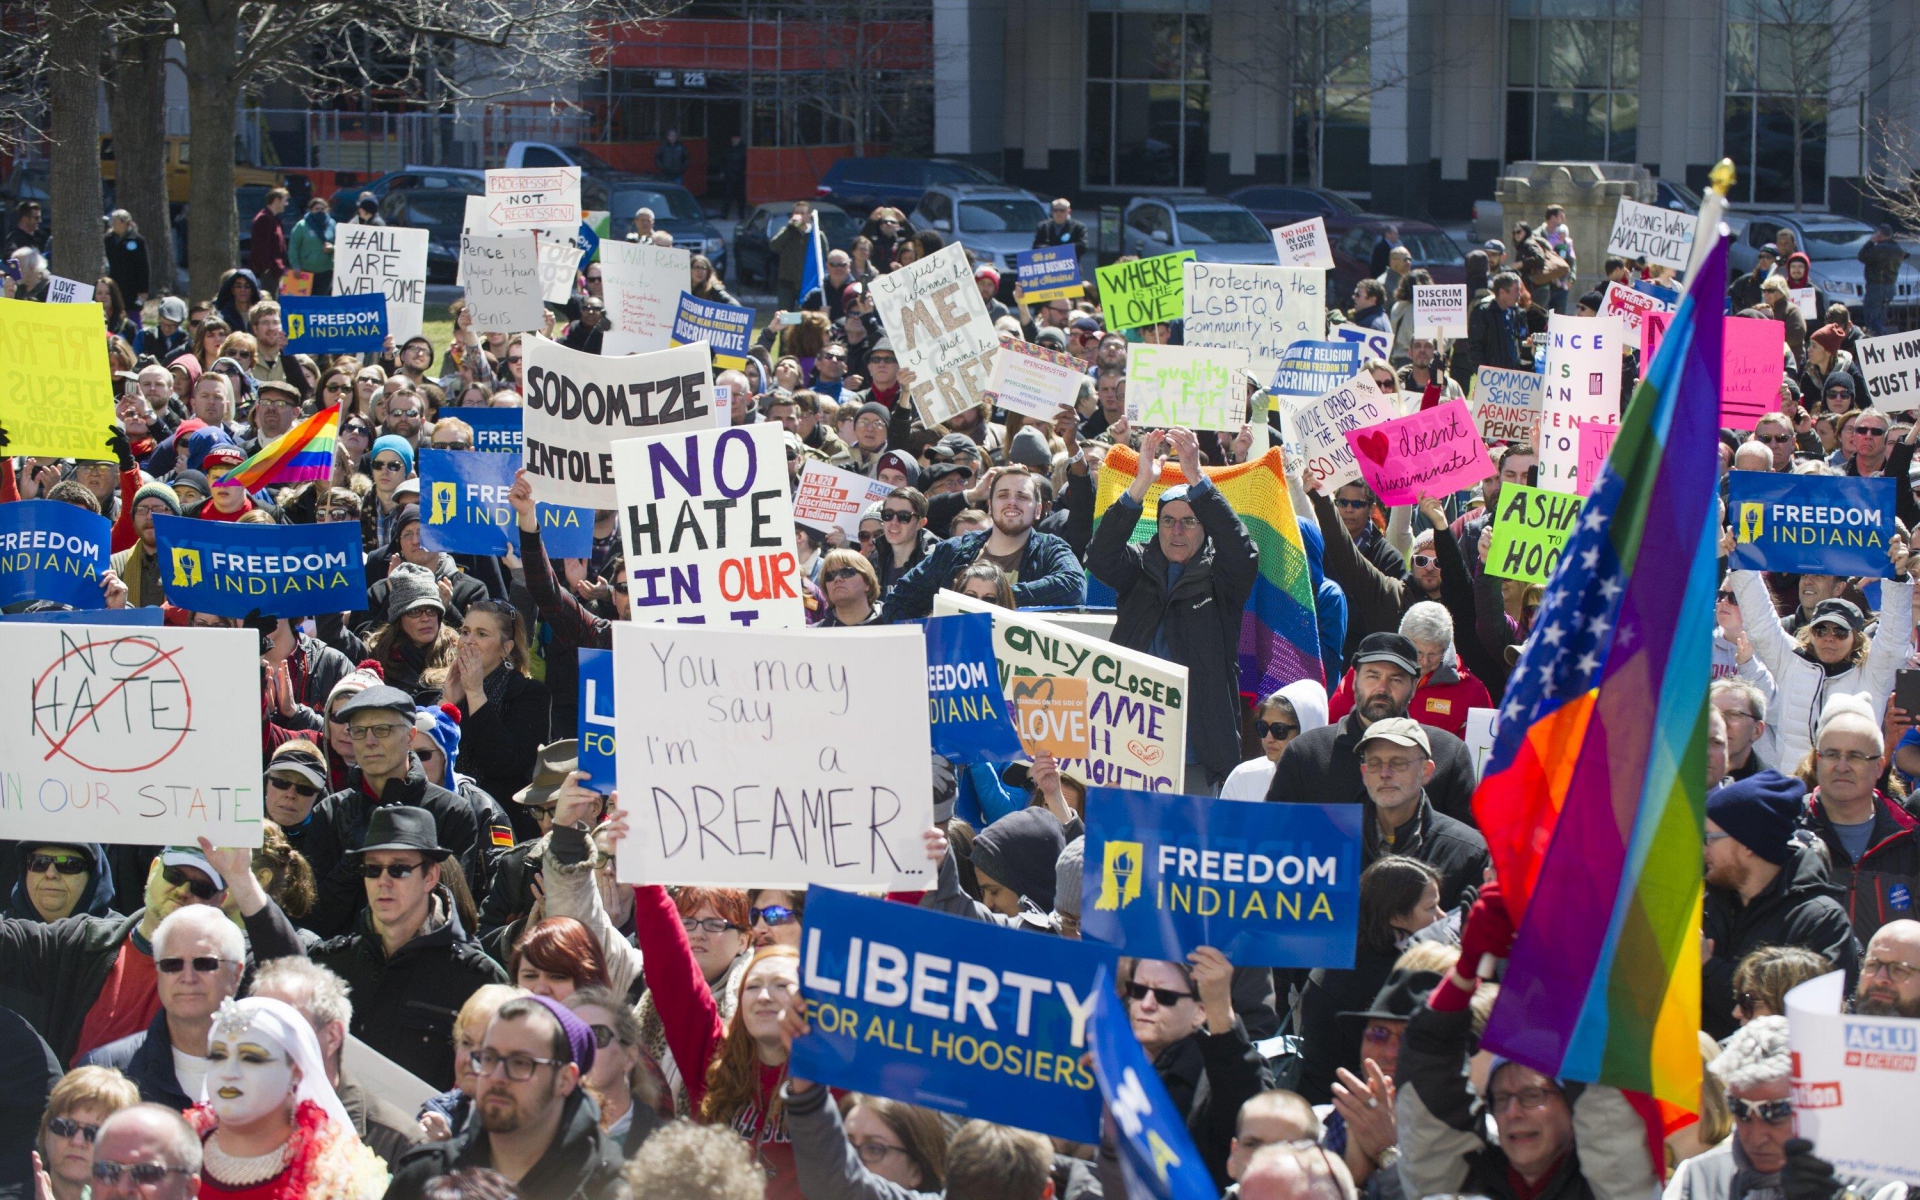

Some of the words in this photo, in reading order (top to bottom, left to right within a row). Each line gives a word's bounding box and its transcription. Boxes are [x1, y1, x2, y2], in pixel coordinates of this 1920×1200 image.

[684, 73, 706, 87] 225
[491, 178, 563, 191] PROGRESSION
[509, 193, 544, 205] NOT
[504, 210, 572, 221] REGRESSION!
[1621, 203, 1662, 233] WRONG
[1664, 212, 1690, 239] WAY
[345, 230, 401, 252] #ALL
[1281, 230, 1294, 239] NO
[1295, 224, 1317, 235] HATE
[1285, 237, 1296, 246] IN
[1297, 232, 1315, 242] OUR
[462, 237, 504, 259] Pence
[513, 245, 526, 259] is
[604, 242, 616, 264] I
[621, 245, 645, 266] Will
[1289, 239, 1315, 252] STATE!
[349, 253, 399, 277] ARE
[500, 262, 536, 277] than
[908, 255, 945, 288] just
[1033, 262, 1045, 275] FOR
[1045, 258, 1075, 273] BUSINESS
[1102, 254, 1183, 295] WHERE
[53, 279, 77, 295] LOVE
[466, 281, 473, 296] A
[482, 279, 528, 296] Duck
[904, 277, 951, 304] wanna
[954, 265, 971, 280] be
[1133, 289, 1145, 300] IS
[1148, 284, 1172, 296] THE
[1193, 264, 1283, 311] Protecting
[1290, 272, 1318, 296] the
[1417, 288, 1462, 298] DISCRIM
[51, 291, 73, 303] WHO
[1190, 294, 1267, 317] LGBTQ
[1417, 298, 1462, 307] INATION
[1614, 288, 1652, 309] WHERE'S
[1623, 302, 1635, 311] THE
[309, 311, 380, 325] FREEDOM
[468, 302, 511, 325] Penis
[681, 298, 704, 316] FREEDOM
[704, 306, 715, 318] OF
[715, 309, 750, 325] RELIGION
[901, 282, 973, 352] ME
[1109, 295, 1175, 329] LOVE
[309, 325, 381, 338] INDIANA
[675, 318, 745, 351] DISCRIMINATE
[1184, 316, 1262, 341] Community
[1270, 318, 1283, 332] is
[1297, 320, 1309, 332] a
[935, 352, 978, 375] wanna
[979, 339, 996, 353] be
[938, 333, 964, 361] just
[1303, 346, 1314, 360] OF
[1314, 348, 1353, 362] RELIGION
[1023, 359, 1068, 378] #PENCEMUSTGO
[1129, 348, 1229, 389] Equality
[1295, 360, 1311, 371] MEAN
[1312, 362, 1340, 373] FREEDOM
[1341, 363, 1349, 373] TO
[1004, 378, 1041, 394] #PENCEMUSTGO
[1355, 381, 1375, 395] SHAME!
[1480, 369, 1543, 392] COMMON
[1869, 371, 1909, 397] JUST
[527, 365, 708, 427] SODOMIZE
[1000, 392, 1037, 409] #PENCEMUSTGO
[1019, 391, 1057, 407] #PENCEMUSTGO
[1181, 382, 1224, 406] For
[1487, 386, 1530, 405] SENSE
[1143, 397, 1225, 430] ALL!
[1295, 406, 1326, 439] YOU'VE
[1323, 388, 1357, 420] OPENED
[1314, 427, 1336, 448] THE
[1335, 413, 1361, 436] DOOR
[1358, 403, 1378, 420] TO
[1477, 404, 1541, 423] AGAINST
[477, 431, 523, 445] FREE
[1483, 420, 1530, 440] PENCE
[1544, 434, 1571, 451] TO
[526, 437, 616, 485] INTOLE
[647, 428, 757, 500] NO
[1308, 456, 1335, 480] SO
[1375, 439, 1481, 493] discriminate!
[806, 473, 834, 486] 18,020
[798, 496, 857, 512] discrimination
[801, 486, 816, 496] say
[818, 488, 829, 496] NO
[831, 490, 840, 499] to
[628, 489, 782, 556] HATE
[795, 506, 805, 516] in
[805, 508, 835, 521] Indiana
[1501, 491, 1582, 531] ASHA
[1772, 504, 1882, 527] FREEDOM
[1547, 534, 1562, 545] TO
[1773, 525, 1882, 548] INDIANA
[2, 552, 97, 582] NDIANA
[211, 551, 347, 574] FREEDOM
[1502, 540, 1563, 578] HOO
[213, 570, 349, 596] INDIANA
[634, 564, 702, 606] IN
[718, 551, 798, 602] OUR
[60, 629, 160, 675] NO
[650, 642, 719, 692] You
[754, 658, 850, 716] may
[928, 662, 989, 691] EEDOM
[1004, 625, 1091, 676] ONLY
[1091, 655, 1182, 709] CLOSED
[32, 676, 197, 736] HATE
[707, 694, 774, 741] say
[930, 694, 998, 725] DIANA
[1089, 691, 1165, 742] AME
[1434, 702, 1450, 711] LOVE
[1018, 709, 1086, 743] LOVE
[646, 735, 698, 766] I'm
[818, 745, 848, 774] a
[0, 771, 23, 810] IN
[39, 778, 121, 815] OUR
[138, 784, 261, 822] STATE
[651, 785, 924, 876] DREAMER...
[1158, 845, 1337, 886] FREEDOM
[1156, 880, 1335, 921] INDIANA
[804, 927, 1099, 1048] LIBERTY
[804, 1000, 858, 1039] FOR
[864, 1015, 924, 1055] ALL
[931, 1028, 1096, 1091] HOOSIERS
[1850, 1025, 1914, 1051] ACLU
